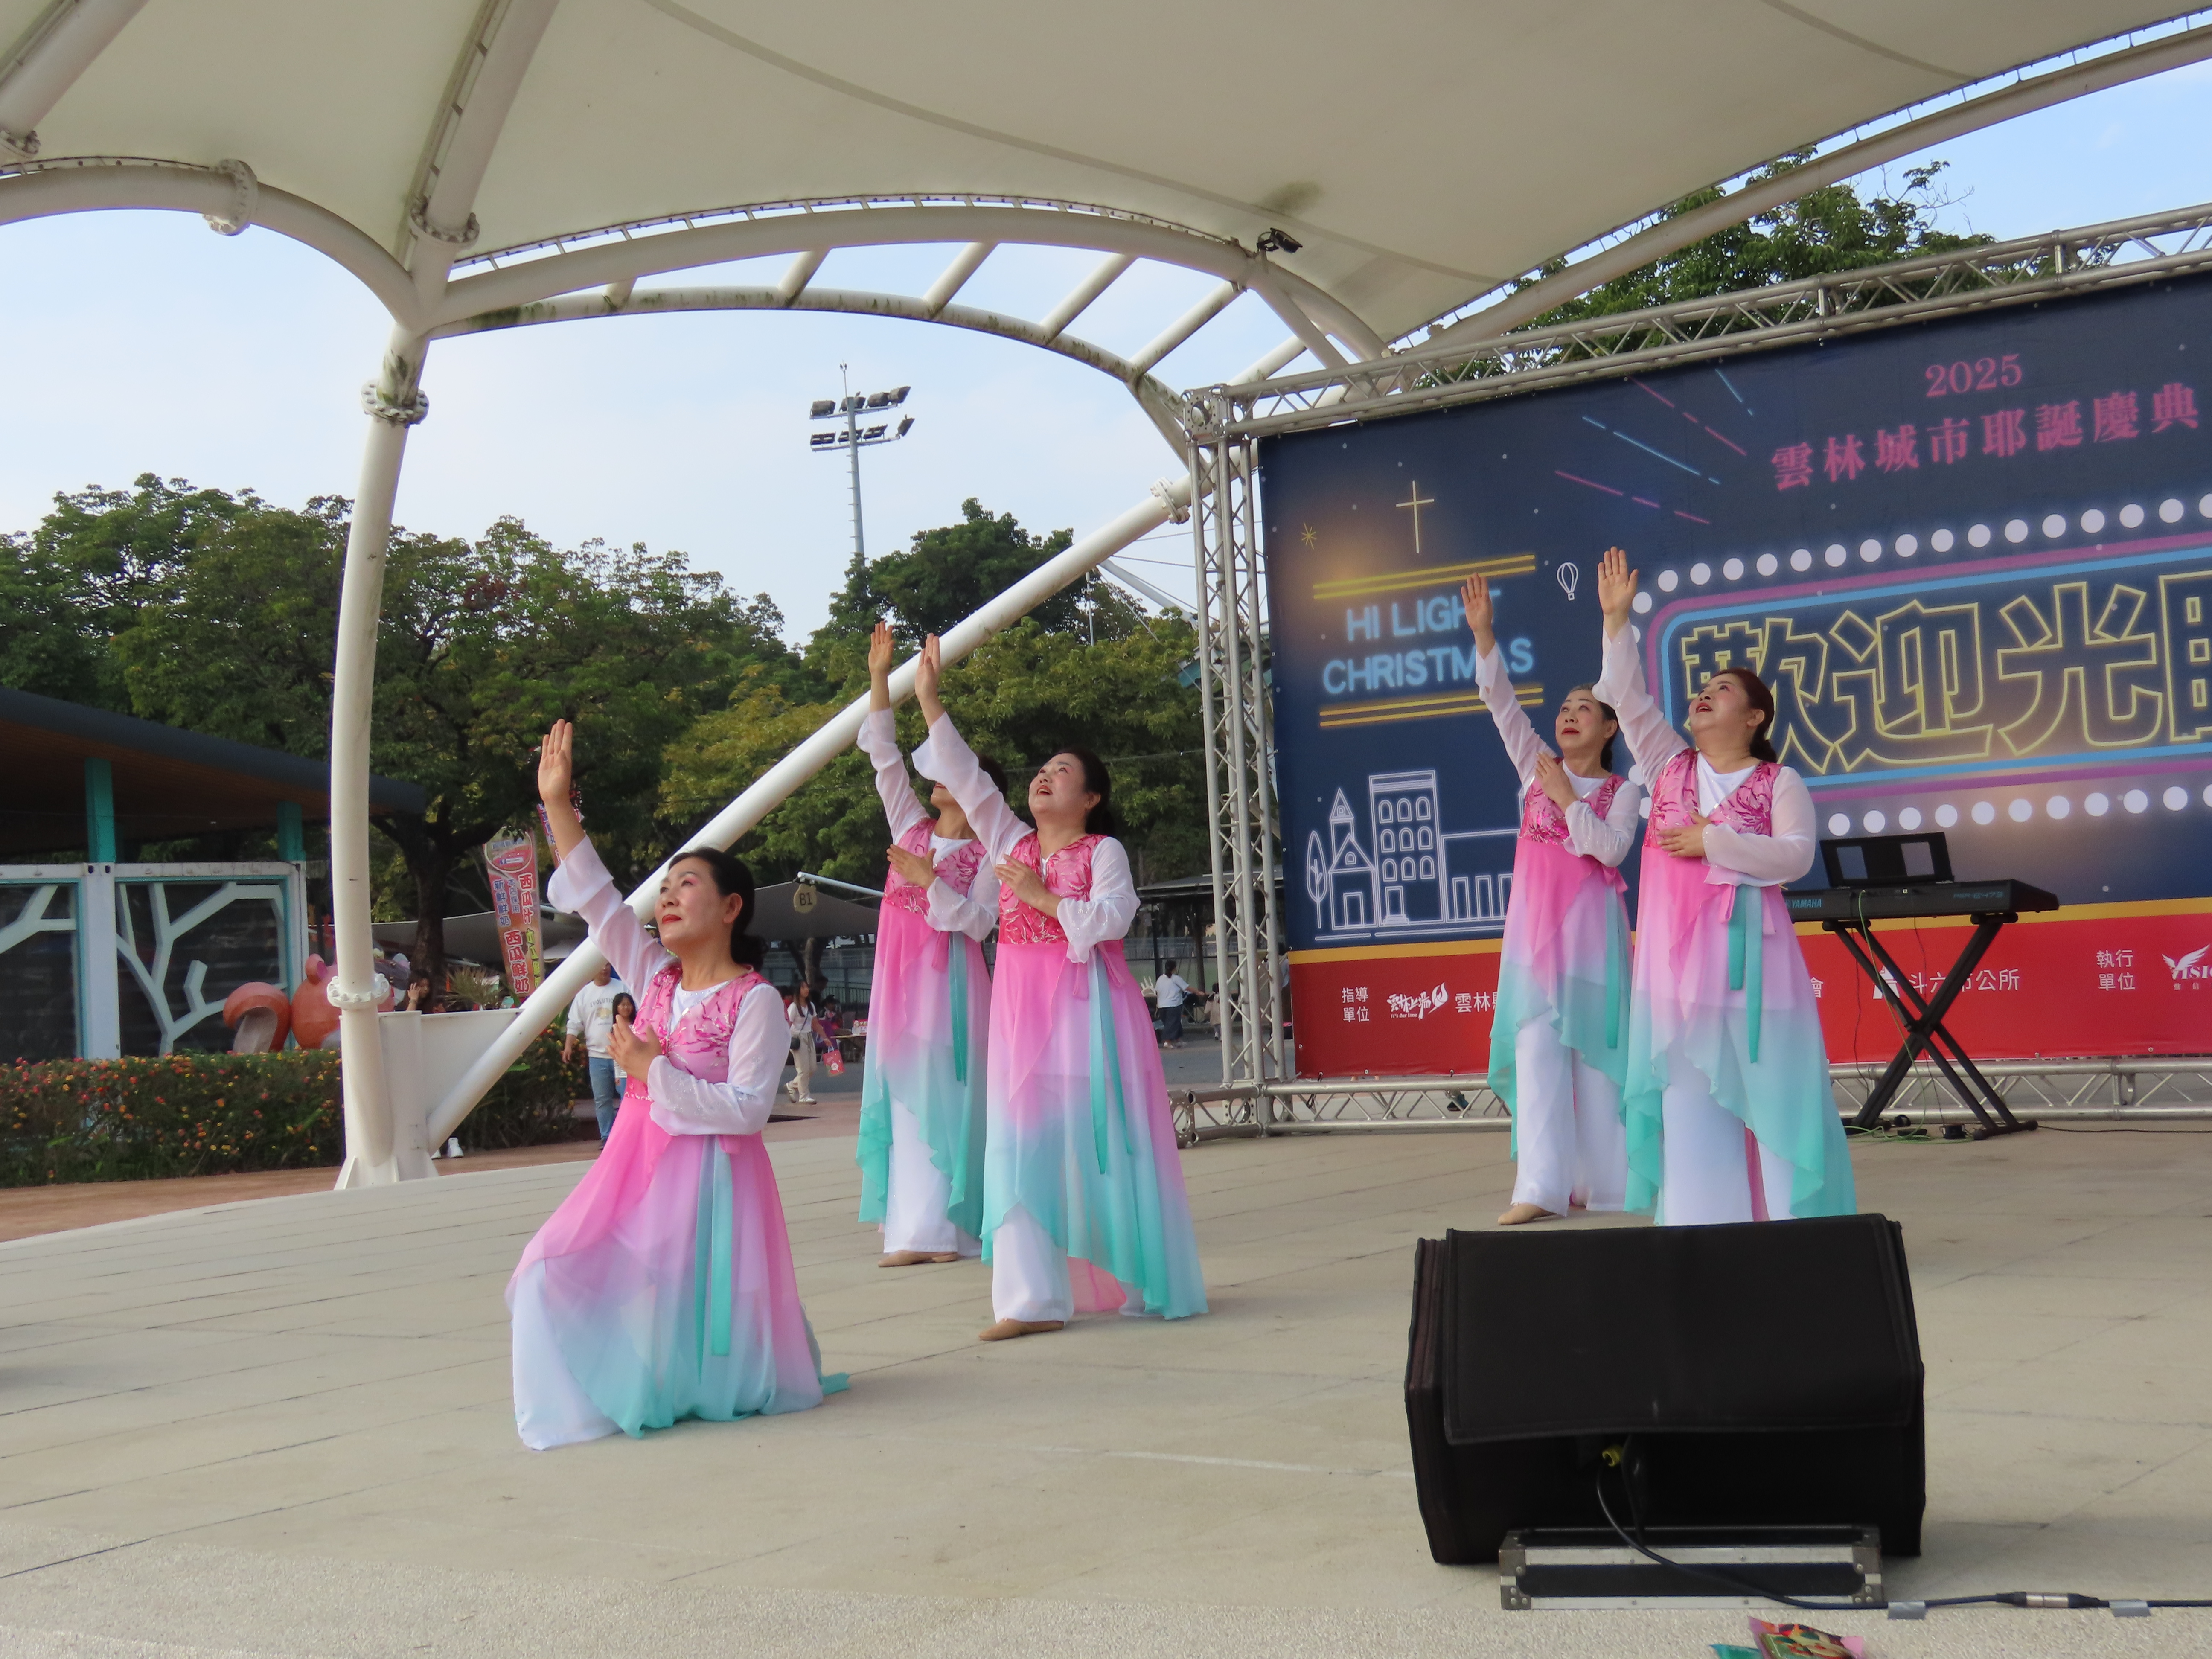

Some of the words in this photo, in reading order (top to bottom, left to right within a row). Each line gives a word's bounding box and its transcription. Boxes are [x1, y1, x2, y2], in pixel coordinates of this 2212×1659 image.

[1924, 353, 2023, 398] 2025
[1771, 382, 2200, 491] 雲林城市耶誕慶典
[1346, 605, 1380, 641] HI
[1391, 588, 1501, 636] LIGH
[493, 879, 511, 927] 新鮮鮮奶
[518, 872, 533, 925] 西瓜汁
[799, 892, 812, 906] B1
[1792, 899, 1822, 908] YAMAHA
[504, 929, 530, 994] 西瓜鮮奶
[2096, 949, 2133, 968] 執行
[1341, 986, 1369, 1004] 指導
[2098, 972, 2136, 991] 單位
[1343, 1006, 1370, 1023] 單位
